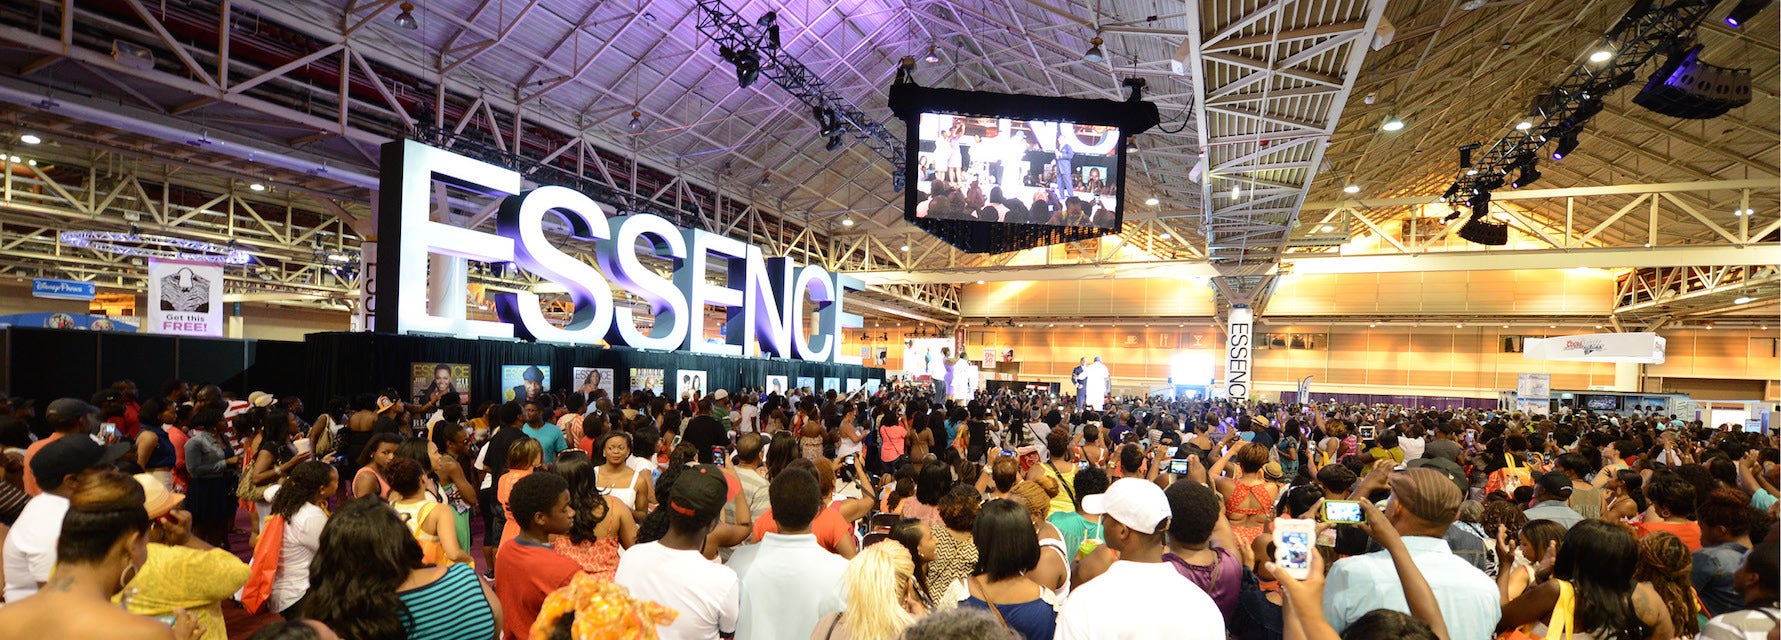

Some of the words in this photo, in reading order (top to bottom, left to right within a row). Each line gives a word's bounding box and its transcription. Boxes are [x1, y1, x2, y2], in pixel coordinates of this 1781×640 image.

[397, 138, 866, 368] ESSENCE
[163, 321, 208, 332] FREE!
[413, 364, 470, 379] ESCE
[576, 369, 612, 381] ESSCE
